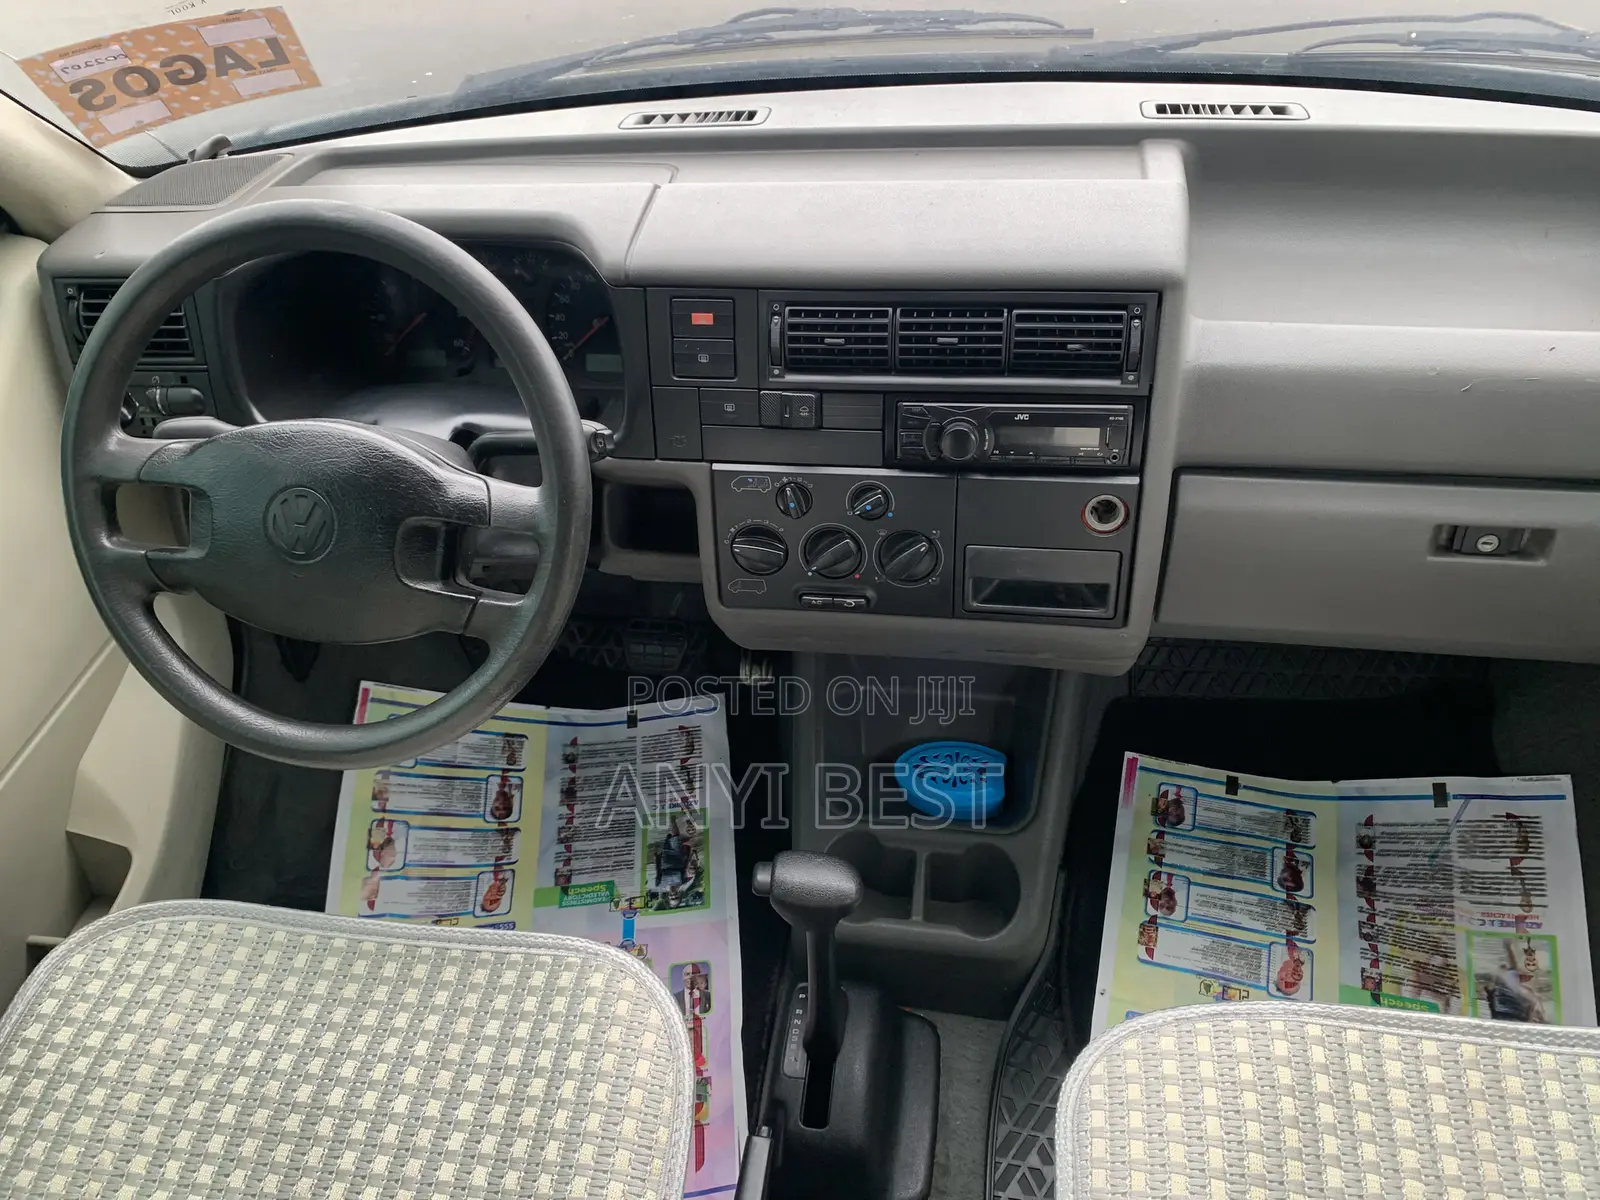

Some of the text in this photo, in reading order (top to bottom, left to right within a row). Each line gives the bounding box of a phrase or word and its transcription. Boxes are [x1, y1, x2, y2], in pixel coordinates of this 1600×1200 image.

[554, 314, 565, 322] 40
[558, 331, 569, 340] 20
[1014, 413, 1030, 421] JVC
[568, 883, 607, 895] Speech
